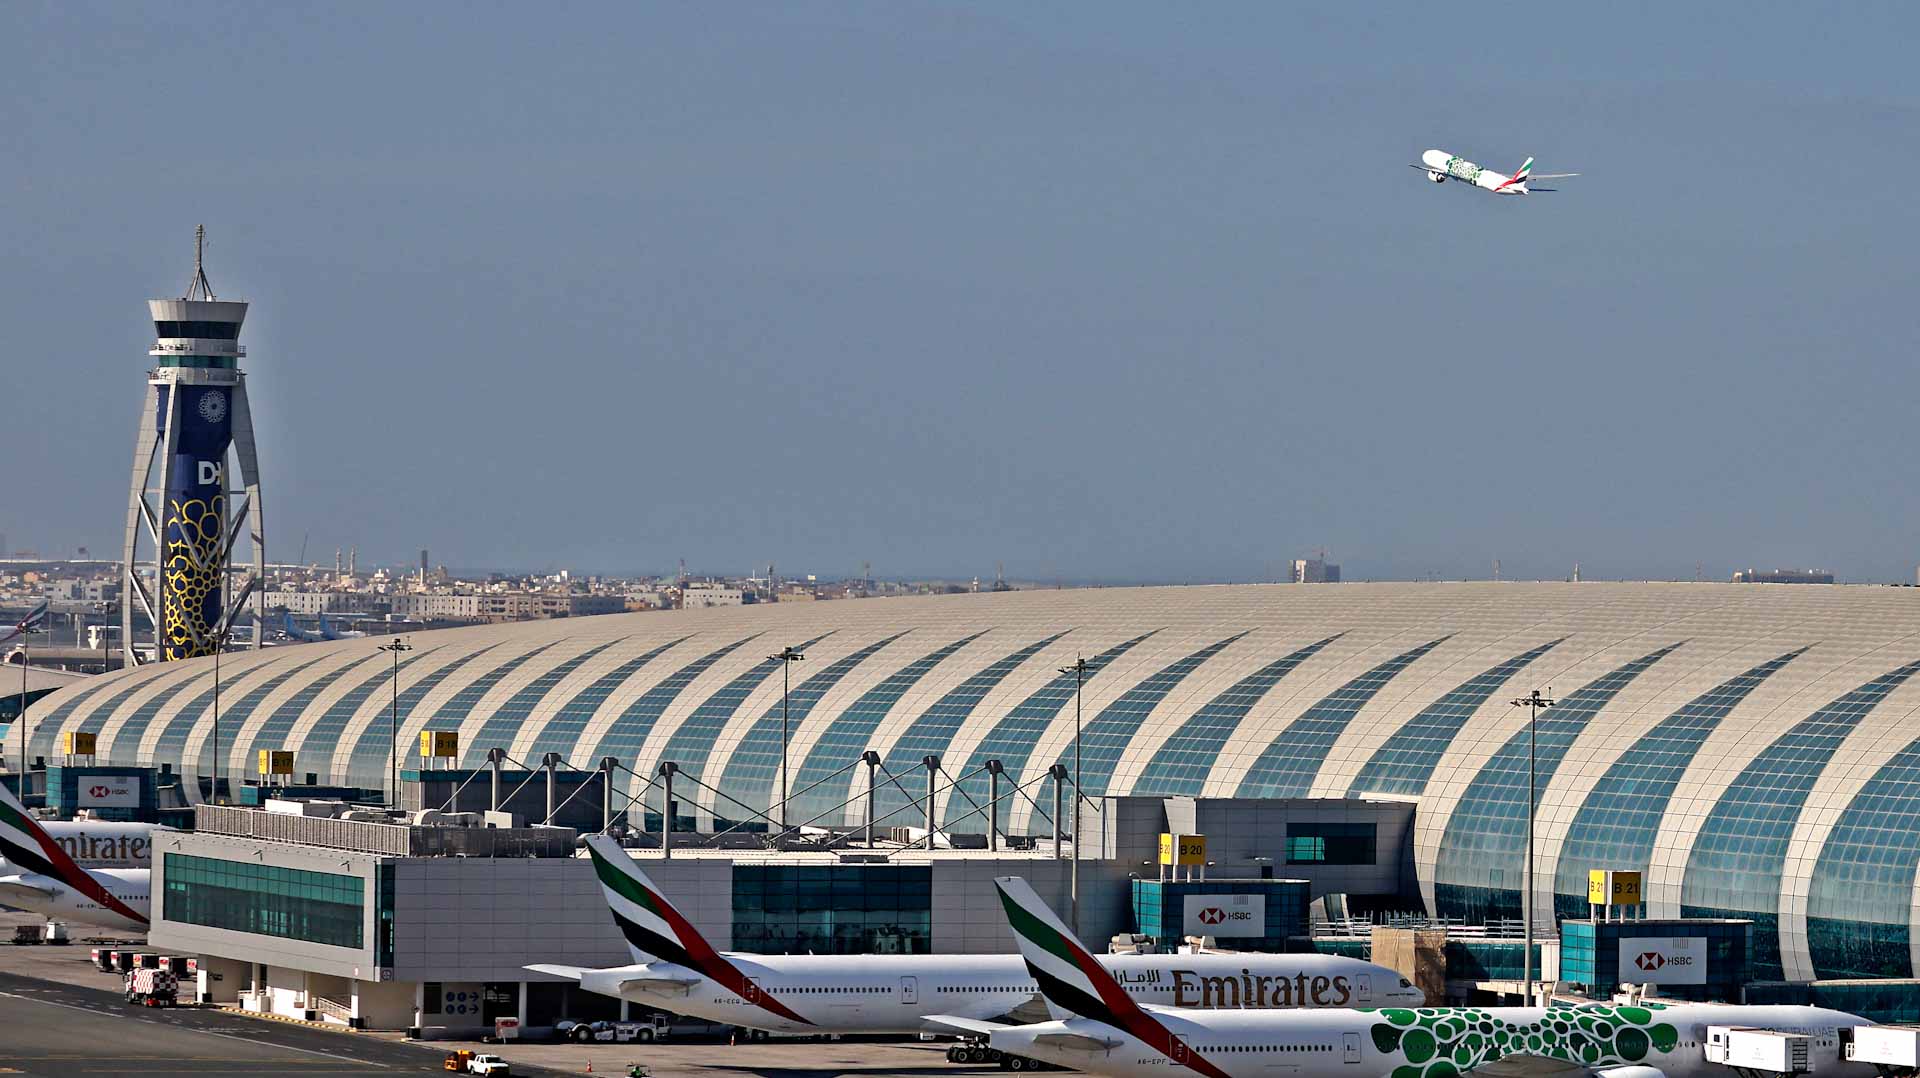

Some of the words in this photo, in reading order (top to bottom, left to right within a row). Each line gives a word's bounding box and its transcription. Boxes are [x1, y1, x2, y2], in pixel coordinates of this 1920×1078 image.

[54, 832, 152, 859] mirate
[1180, 845, 1188, 855] B
[1190, 845, 1202, 855] 20
[1596, 882, 1603, 892] 21
[1614, 883, 1622, 893] B
[1627, 883, 1639, 893] 21
[1228, 912, 1251, 921] HSBC
[1667, 957, 1692, 966] HSBC
[1113, 969, 1161, 986] الإمارا
[1171, 969, 1350, 1007] Emirates
